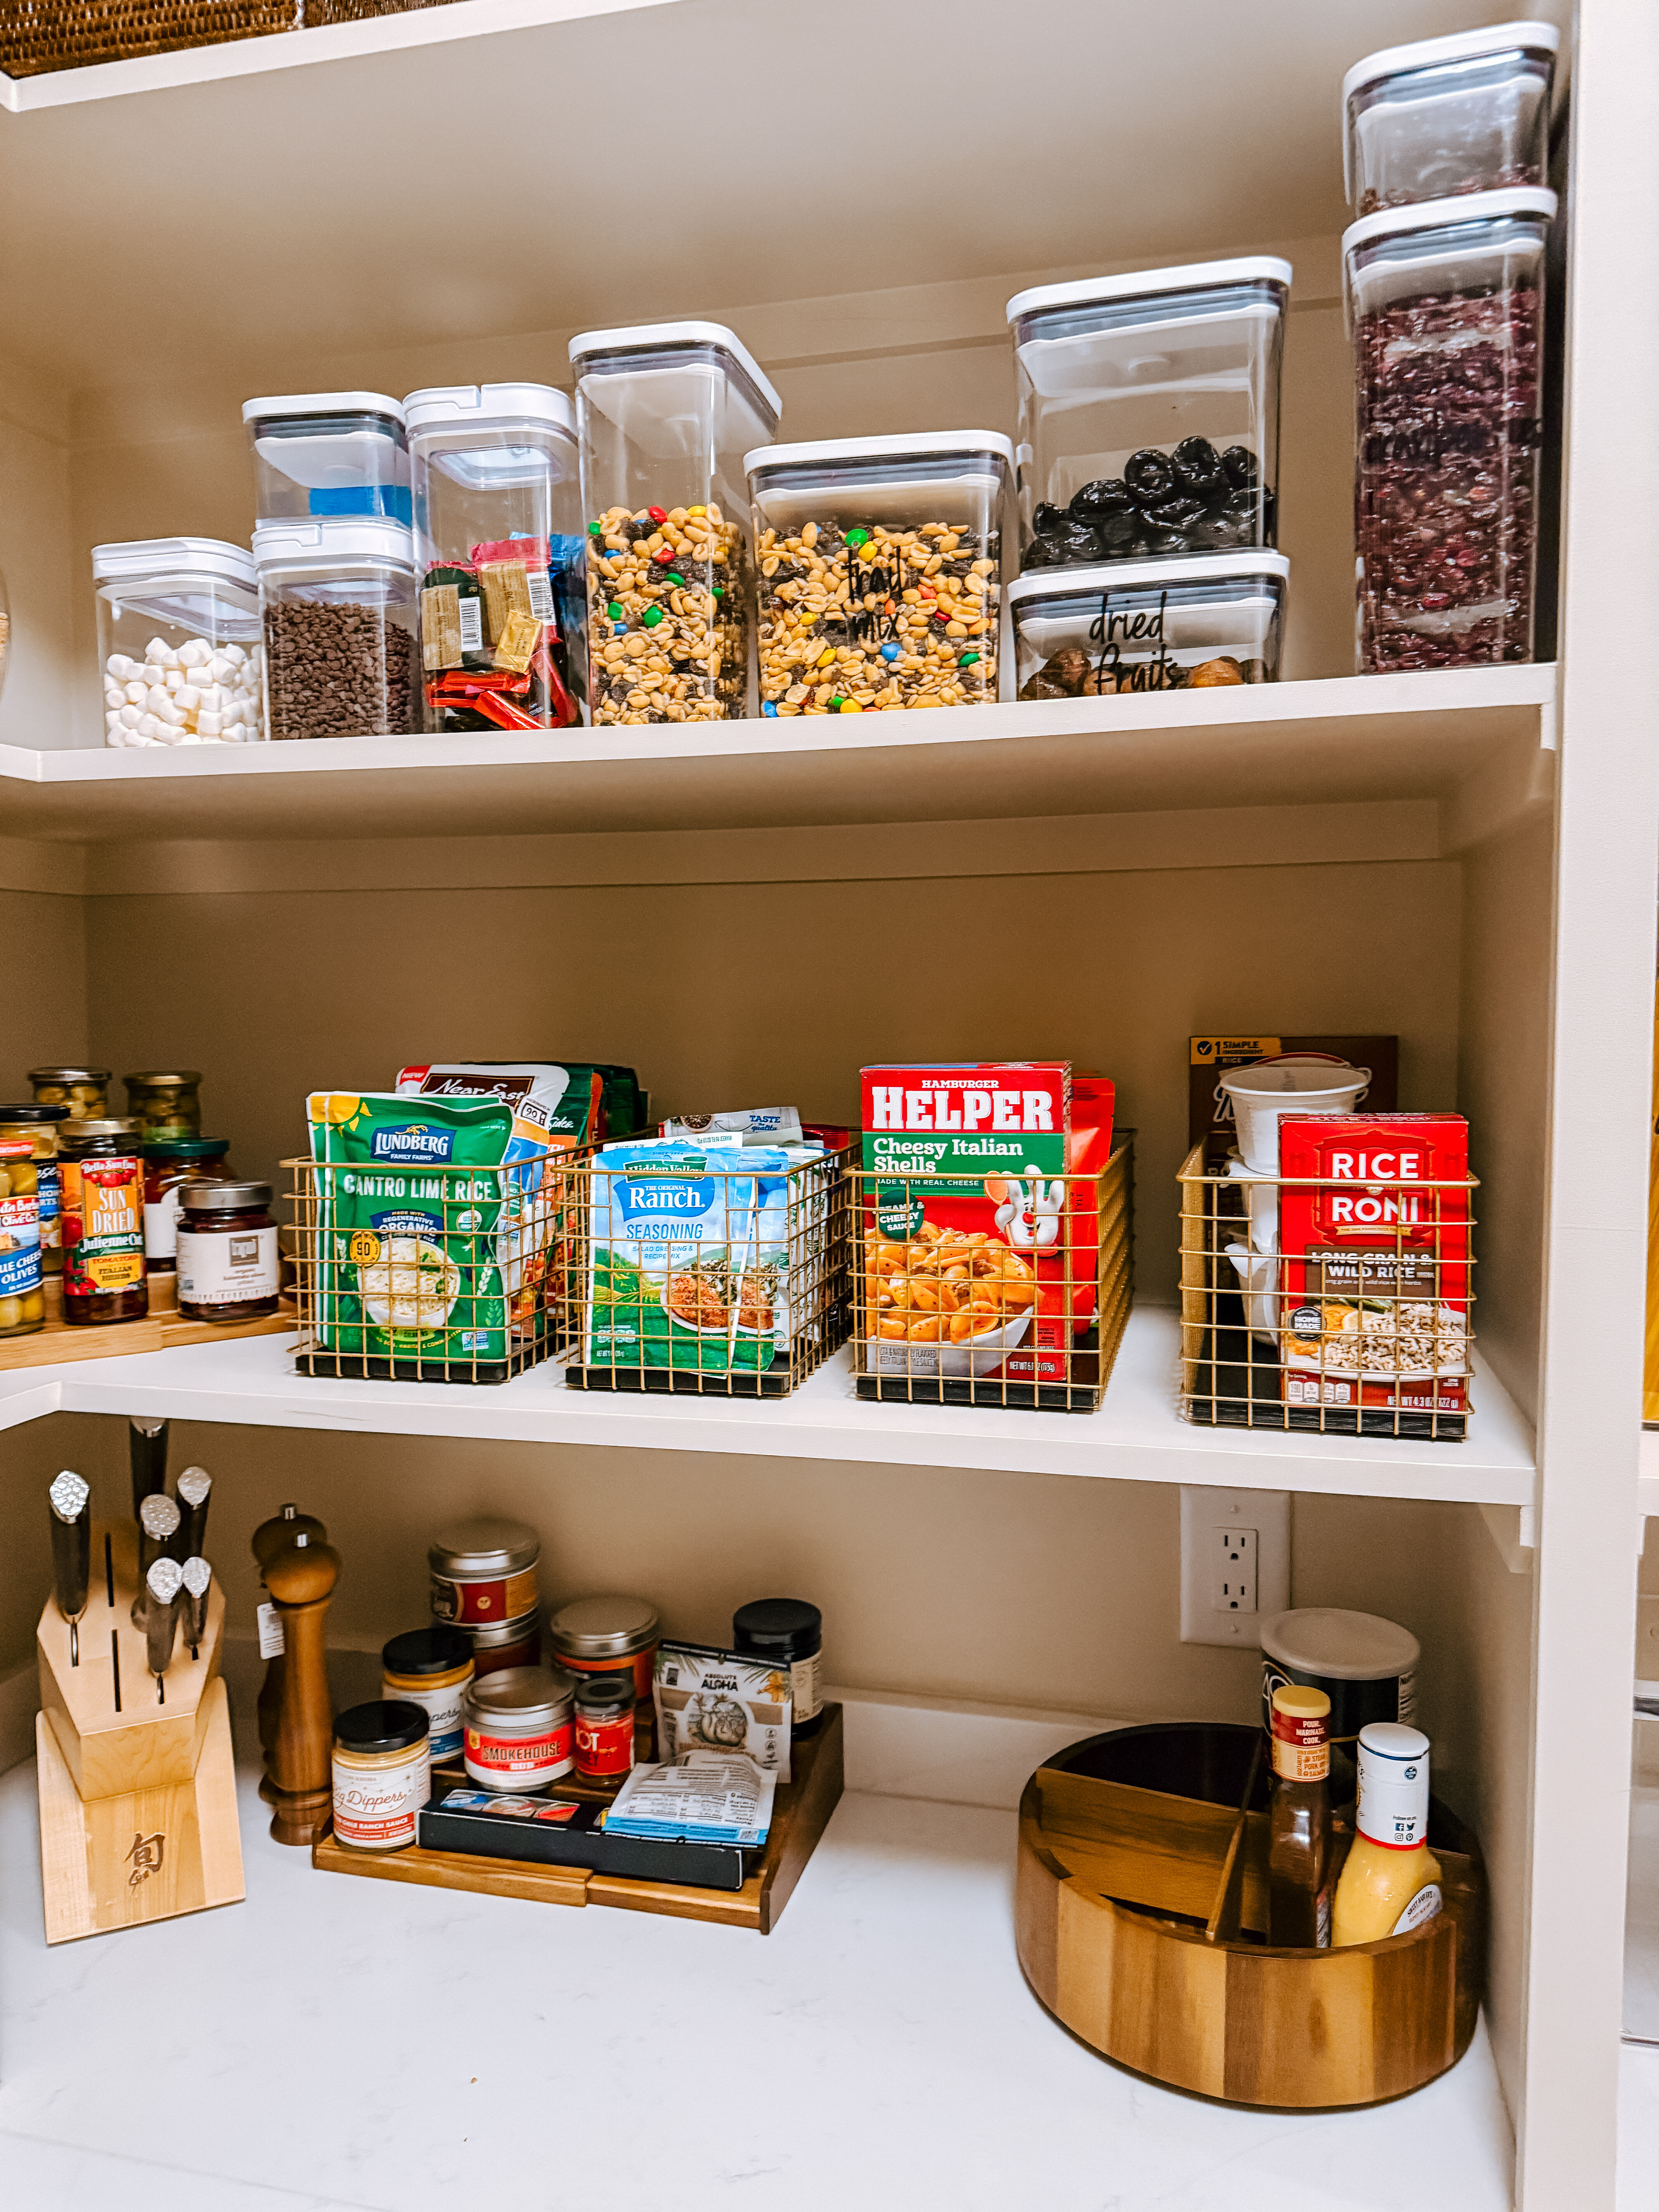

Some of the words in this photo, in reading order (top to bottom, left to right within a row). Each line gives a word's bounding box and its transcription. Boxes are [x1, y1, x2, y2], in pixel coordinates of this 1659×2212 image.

[1089, 591, 1167, 644] dried
[1093, 643, 1178, 695] fruits
[1215, 1041, 1220, 1054] 1
[423, 1079, 486, 1095] Near
[485, 1084, 526, 1100] East
[922, 1080, 1000, 1089] HAMBURGER
[527, 1107, 538, 1118] 90
[872, 1086, 1054, 1130] HELPER
[749, 1115, 781, 1123] TASTE
[374, 1132, 449, 1156] LUNDBERG
[873, 1138, 948, 1160] Cheesy
[951, 1138, 1024, 1156] Italian
[628, 1164, 668, 1174] Hidden
[874, 1156, 936, 1173] Shells
[1332, 1153, 1419, 1179] RICE
[410, 1178, 449, 1200] LIME
[455, 1180, 493, 1200] RICE
[99, 1188, 126, 1211] SUN
[873, 1202, 914, 1214] REAMY
[916, 1201, 925, 1209] &
[1075, 1192, 1083, 1212] TYLE
[879, 1212, 919, 1224] CHEESY
[1332, 1197, 1418, 1222] RONI
[92, 1207, 135, 1233] DRIED
[382, 1216, 434, 1226] REGENERATIVE
[887, 1222, 915, 1231] SAUCE
[378, 1221, 438, 1237] ORGANIC
[627, 1224, 703, 1239] SEASONING
[79, 1235, 128, 1253] Julienne
[357, 1242, 370, 1255] 90
[1312, 1252, 1358, 1264] LONG
[1363, 1253, 1415, 1265] GRAN
[1420, 1254, 1432, 1265] &
[1, 1263, 37, 1284] OLIVES
[1328, 1265, 1373, 1277] WILD
[1377, 1266, 1415, 1278] RICE
[1387, 1396, 1396, 1406] NE
[1413, 1396, 1425, 1407] 4.3
[701, 1679, 738, 1692] ALOHA
[483, 1740, 562, 1760] SMOKEHOUSE
[347, 1790, 406, 1812] Dippers
